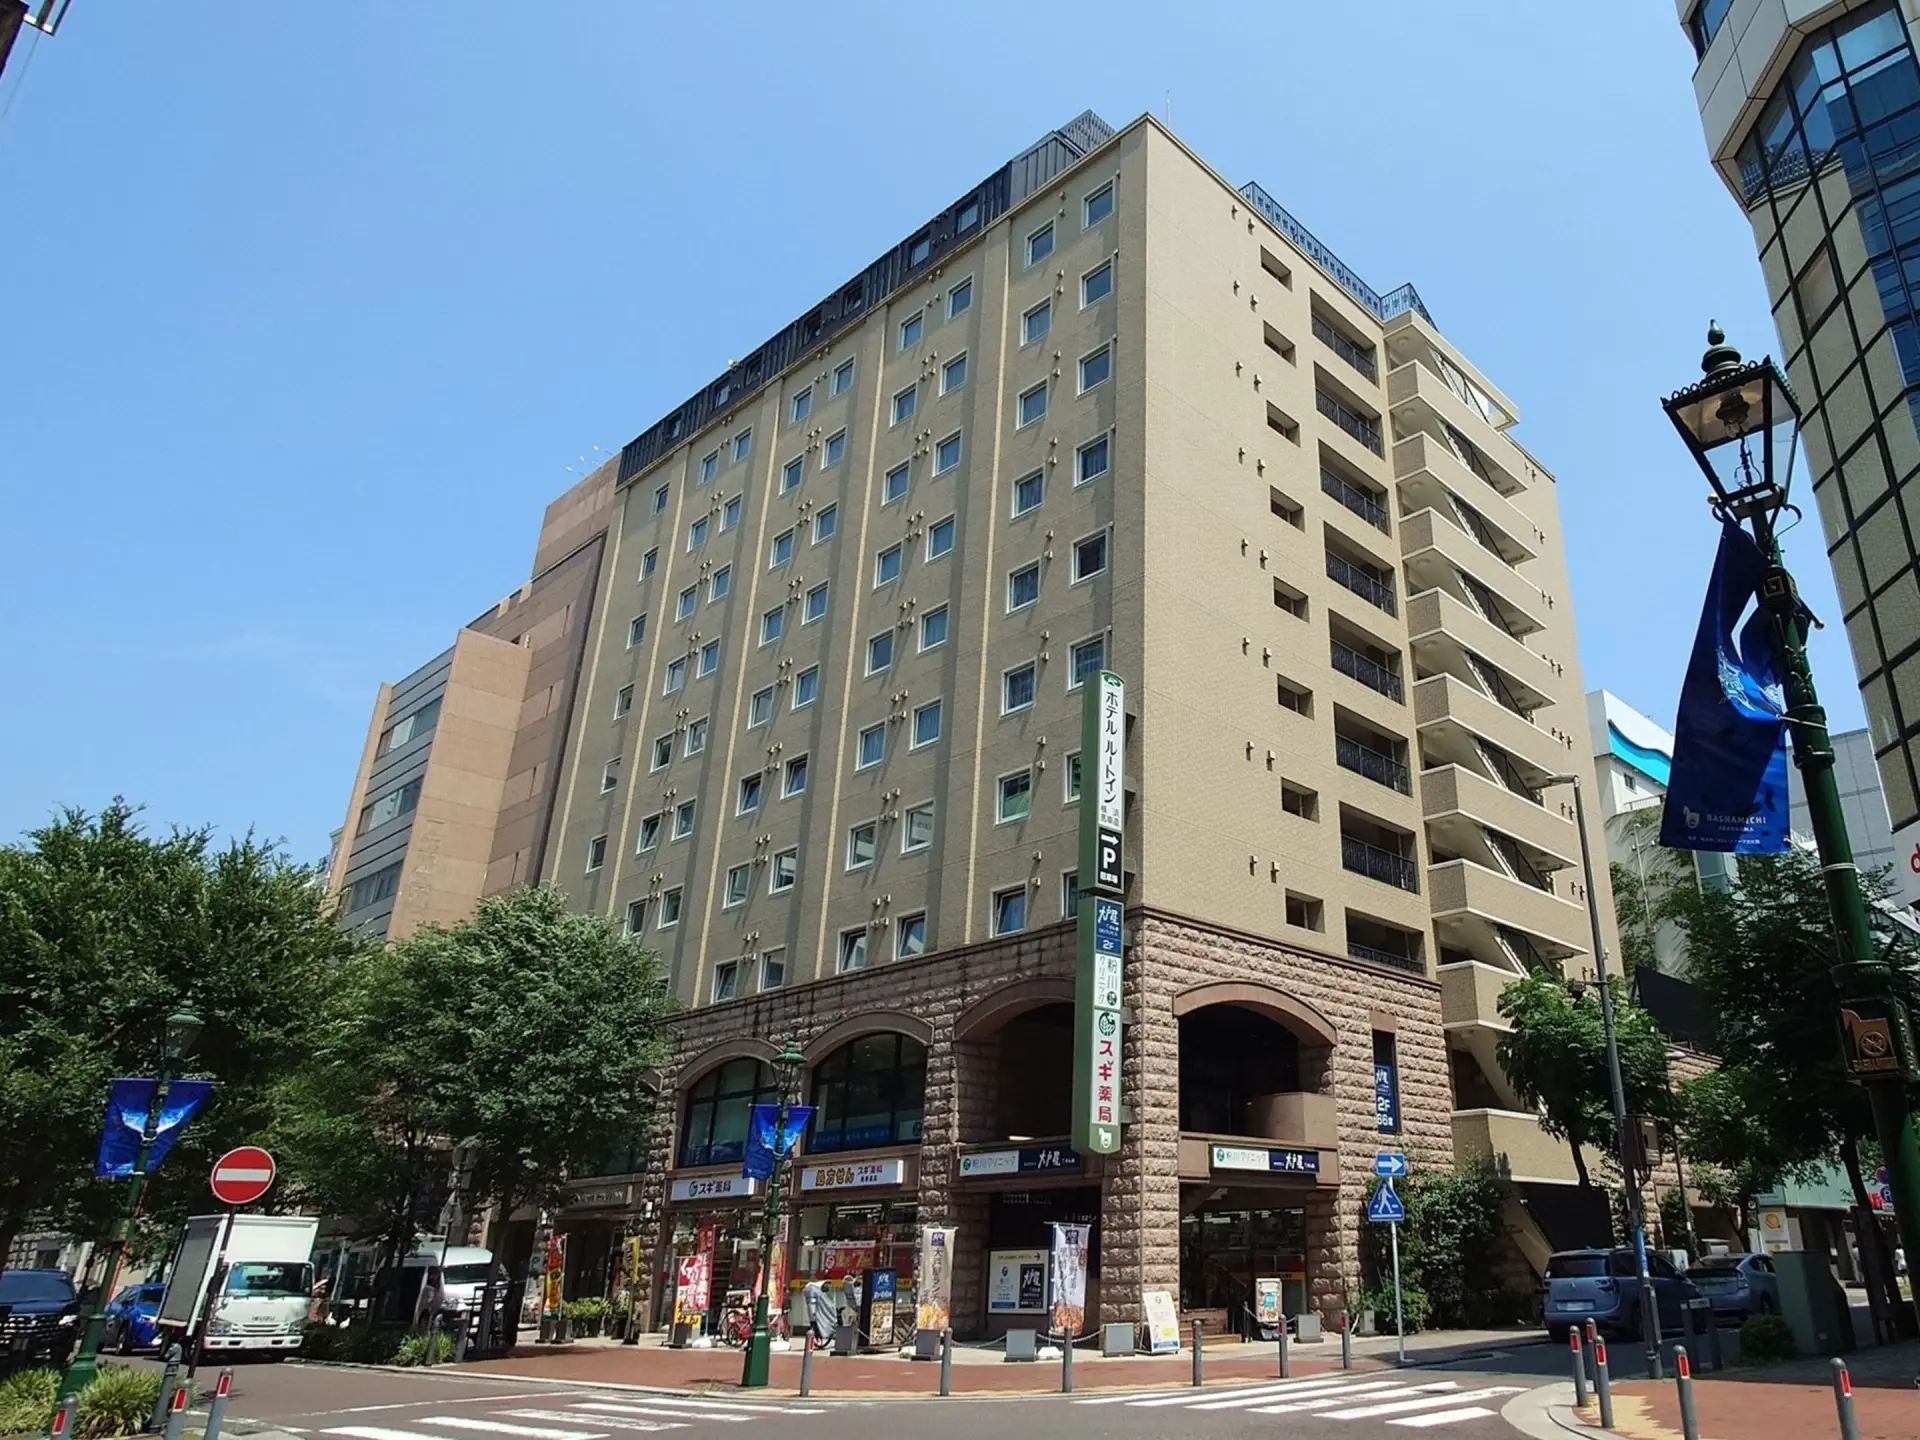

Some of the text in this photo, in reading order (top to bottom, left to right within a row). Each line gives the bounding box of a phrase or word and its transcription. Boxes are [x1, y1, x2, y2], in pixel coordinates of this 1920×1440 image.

[1105, 691, 1118, 735] ホテル
[1706, 813, 1767, 824] BASHAMICHI
[1103, 847, 1116, 869] P
[1103, 939, 1114, 950] 2F
[1098, 1040, 1114, 1122] スギ薬局
[1377, 1096, 1391, 1111] 2F
[815, 1168, 855, 1187] 処方せん
[698, 1180, 732, 1195] スギ薬局
